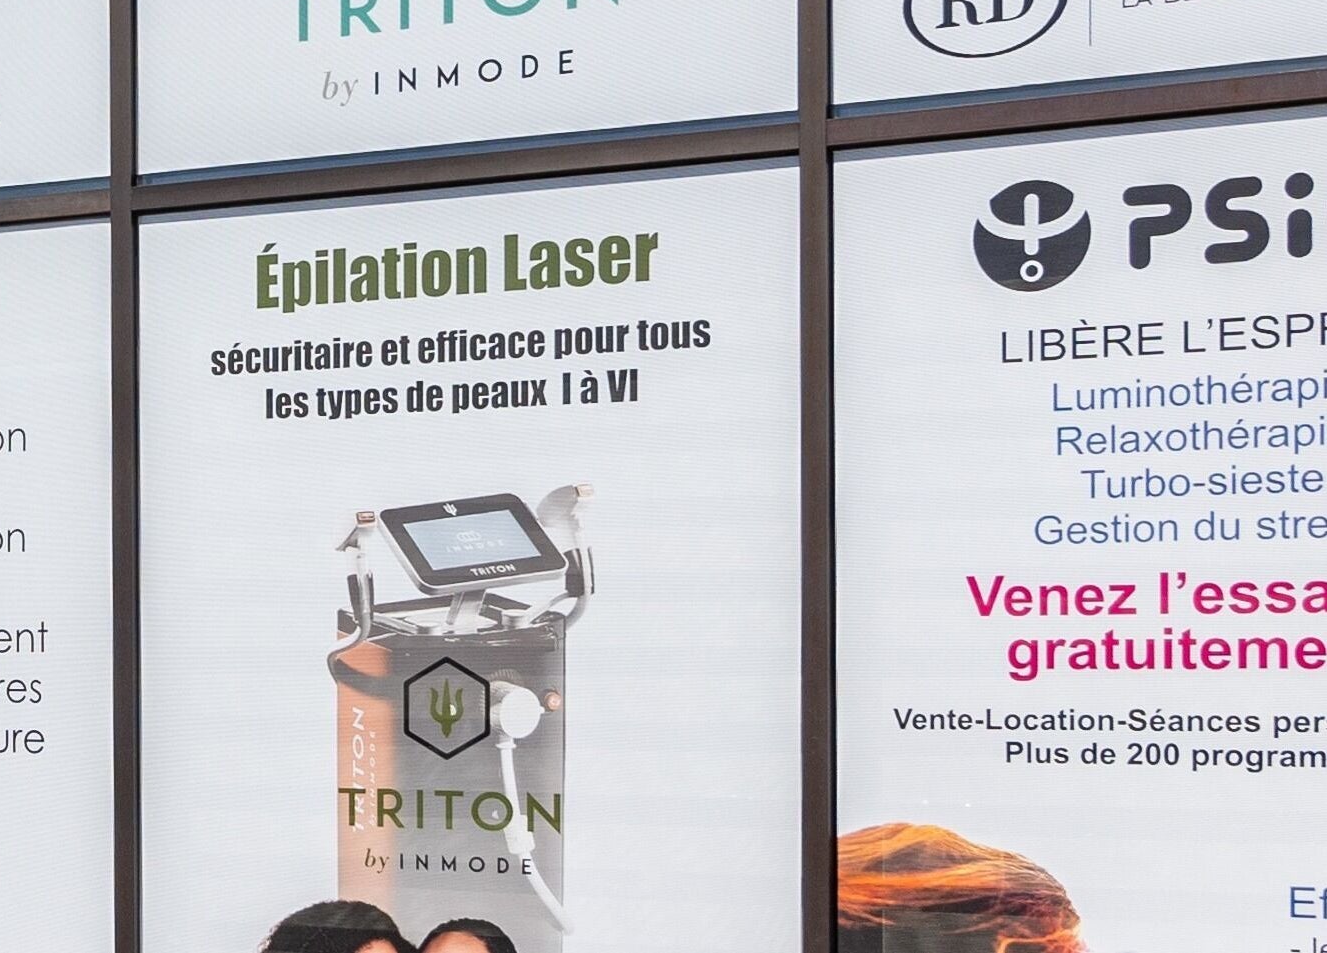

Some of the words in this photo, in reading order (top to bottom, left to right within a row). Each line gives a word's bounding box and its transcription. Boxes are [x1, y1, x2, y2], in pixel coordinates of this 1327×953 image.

[321, 70, 359, 107] by
[374, 49, 575, 95] INMODE
[256, 242, 488, 313] Épilation
[504, 232, 659, 293] Laser
[210, 337, 373, 377] sécuritaire
[380, 335, 411, 366] et
[417, 327, 546, 366] efficace
[553, 325, 630, 360] pour
[637, 318, 712, 351] tous
[1000, 319, 1165, 364] LIBÈRE
[1183, 311, 1327, 354] L'ESP
[265, 387, 310, 420] les
[316, 382, 399, 421] types
[406, 380, 444, 413] de
[451, 378, 548, 416] peaux
[562, 373, 572, 405] I
[579, 370, 600, 404] à
[607, 368, 640, 403] VI
[1056, 416, 1325, 457] Relaxothérapi
[1081, 464, 1324, 501] Turbo-sieste
[1034, 514, 1179, 544] Gestion
[1194, 511, 1241, 542] du
[1256, 510, 1327, 540] stre
[470, 564, 517, 577] TRITON
[965, 575, 1137, 617] Venez
[1006, 627, 1327, 682] gratuiteme
[893, 708, 1261, 733] Vente-Location-Séances
[1273, 715, 1327, 738] per
[1004, 742, 1070, 765] Plus
[1080, 743, 1117, 765] de
[1126, 743, 1180, 766] 200
[338, 787, 562, 835] TRITON
[364, 847, 390, 874] by
[399, 852, 534, 875] INMODE
